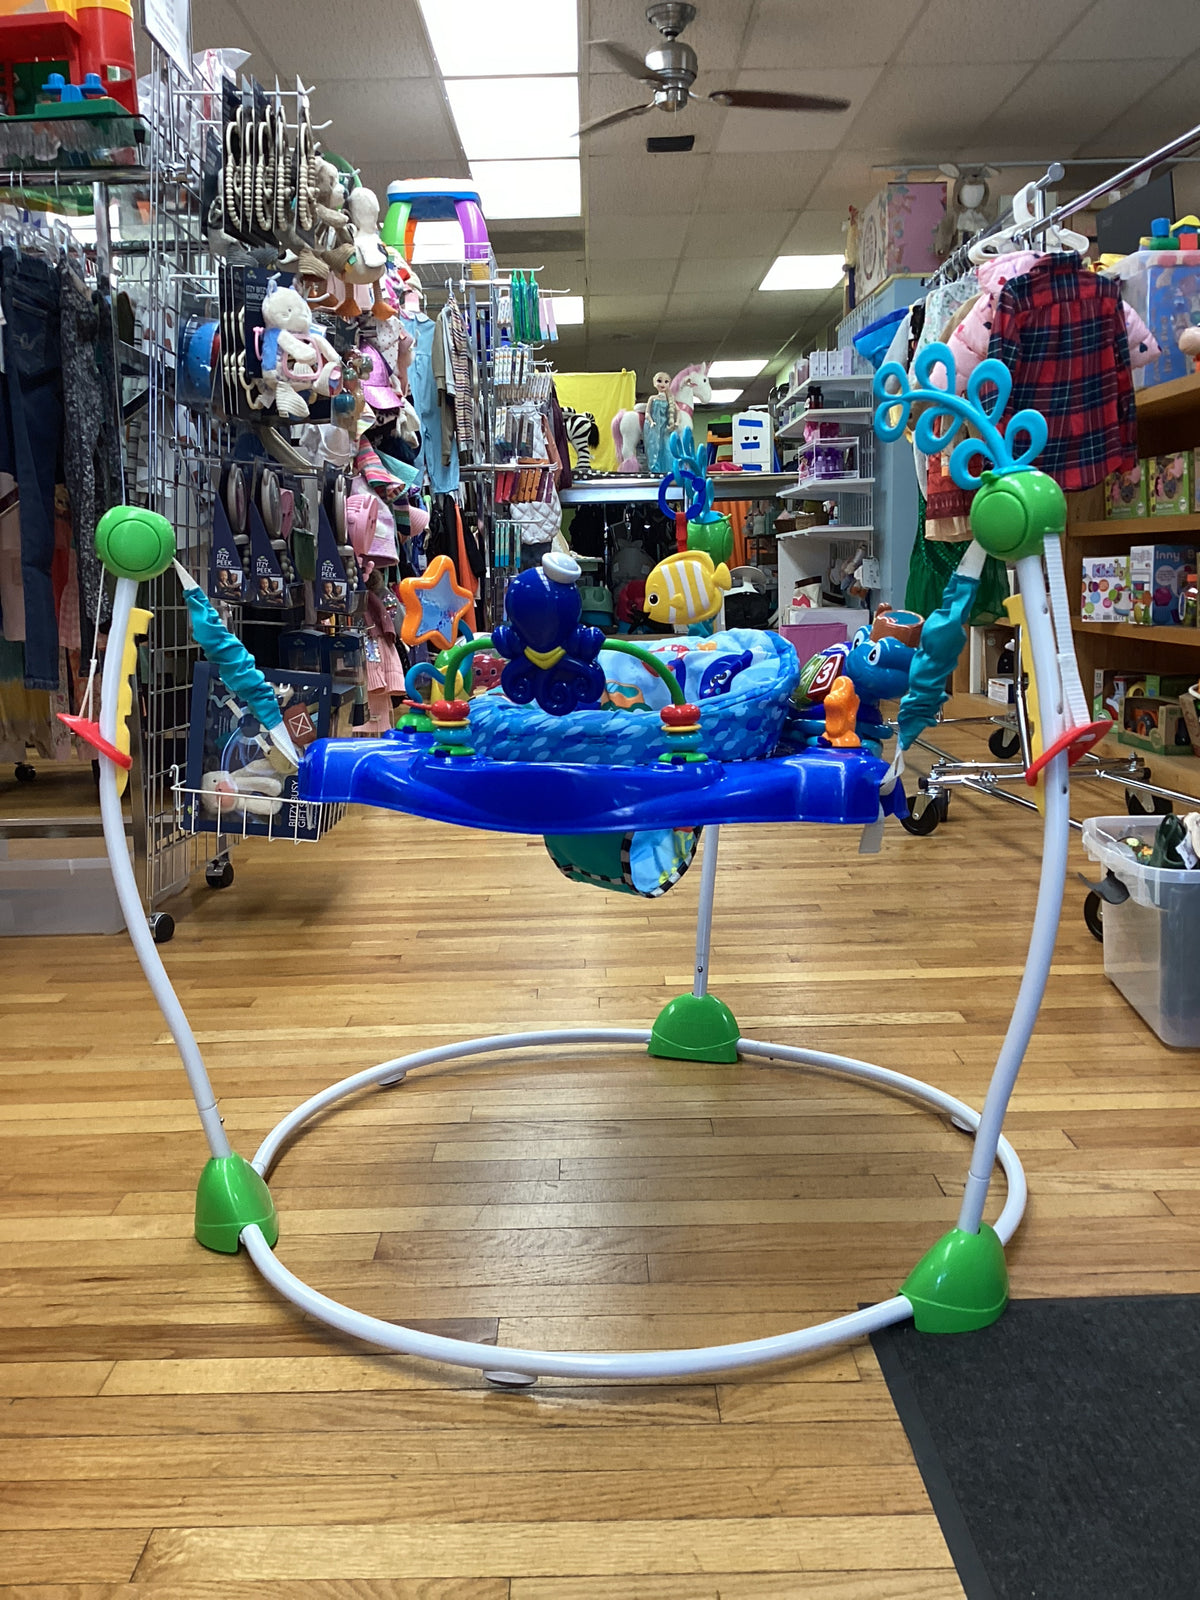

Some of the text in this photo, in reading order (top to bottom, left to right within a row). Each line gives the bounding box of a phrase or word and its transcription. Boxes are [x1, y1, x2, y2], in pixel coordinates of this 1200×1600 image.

[816, 662, 833, 684] 3
[288, 804, 297, 827] BITZY
[297, 809, 306, 828] GIFT
